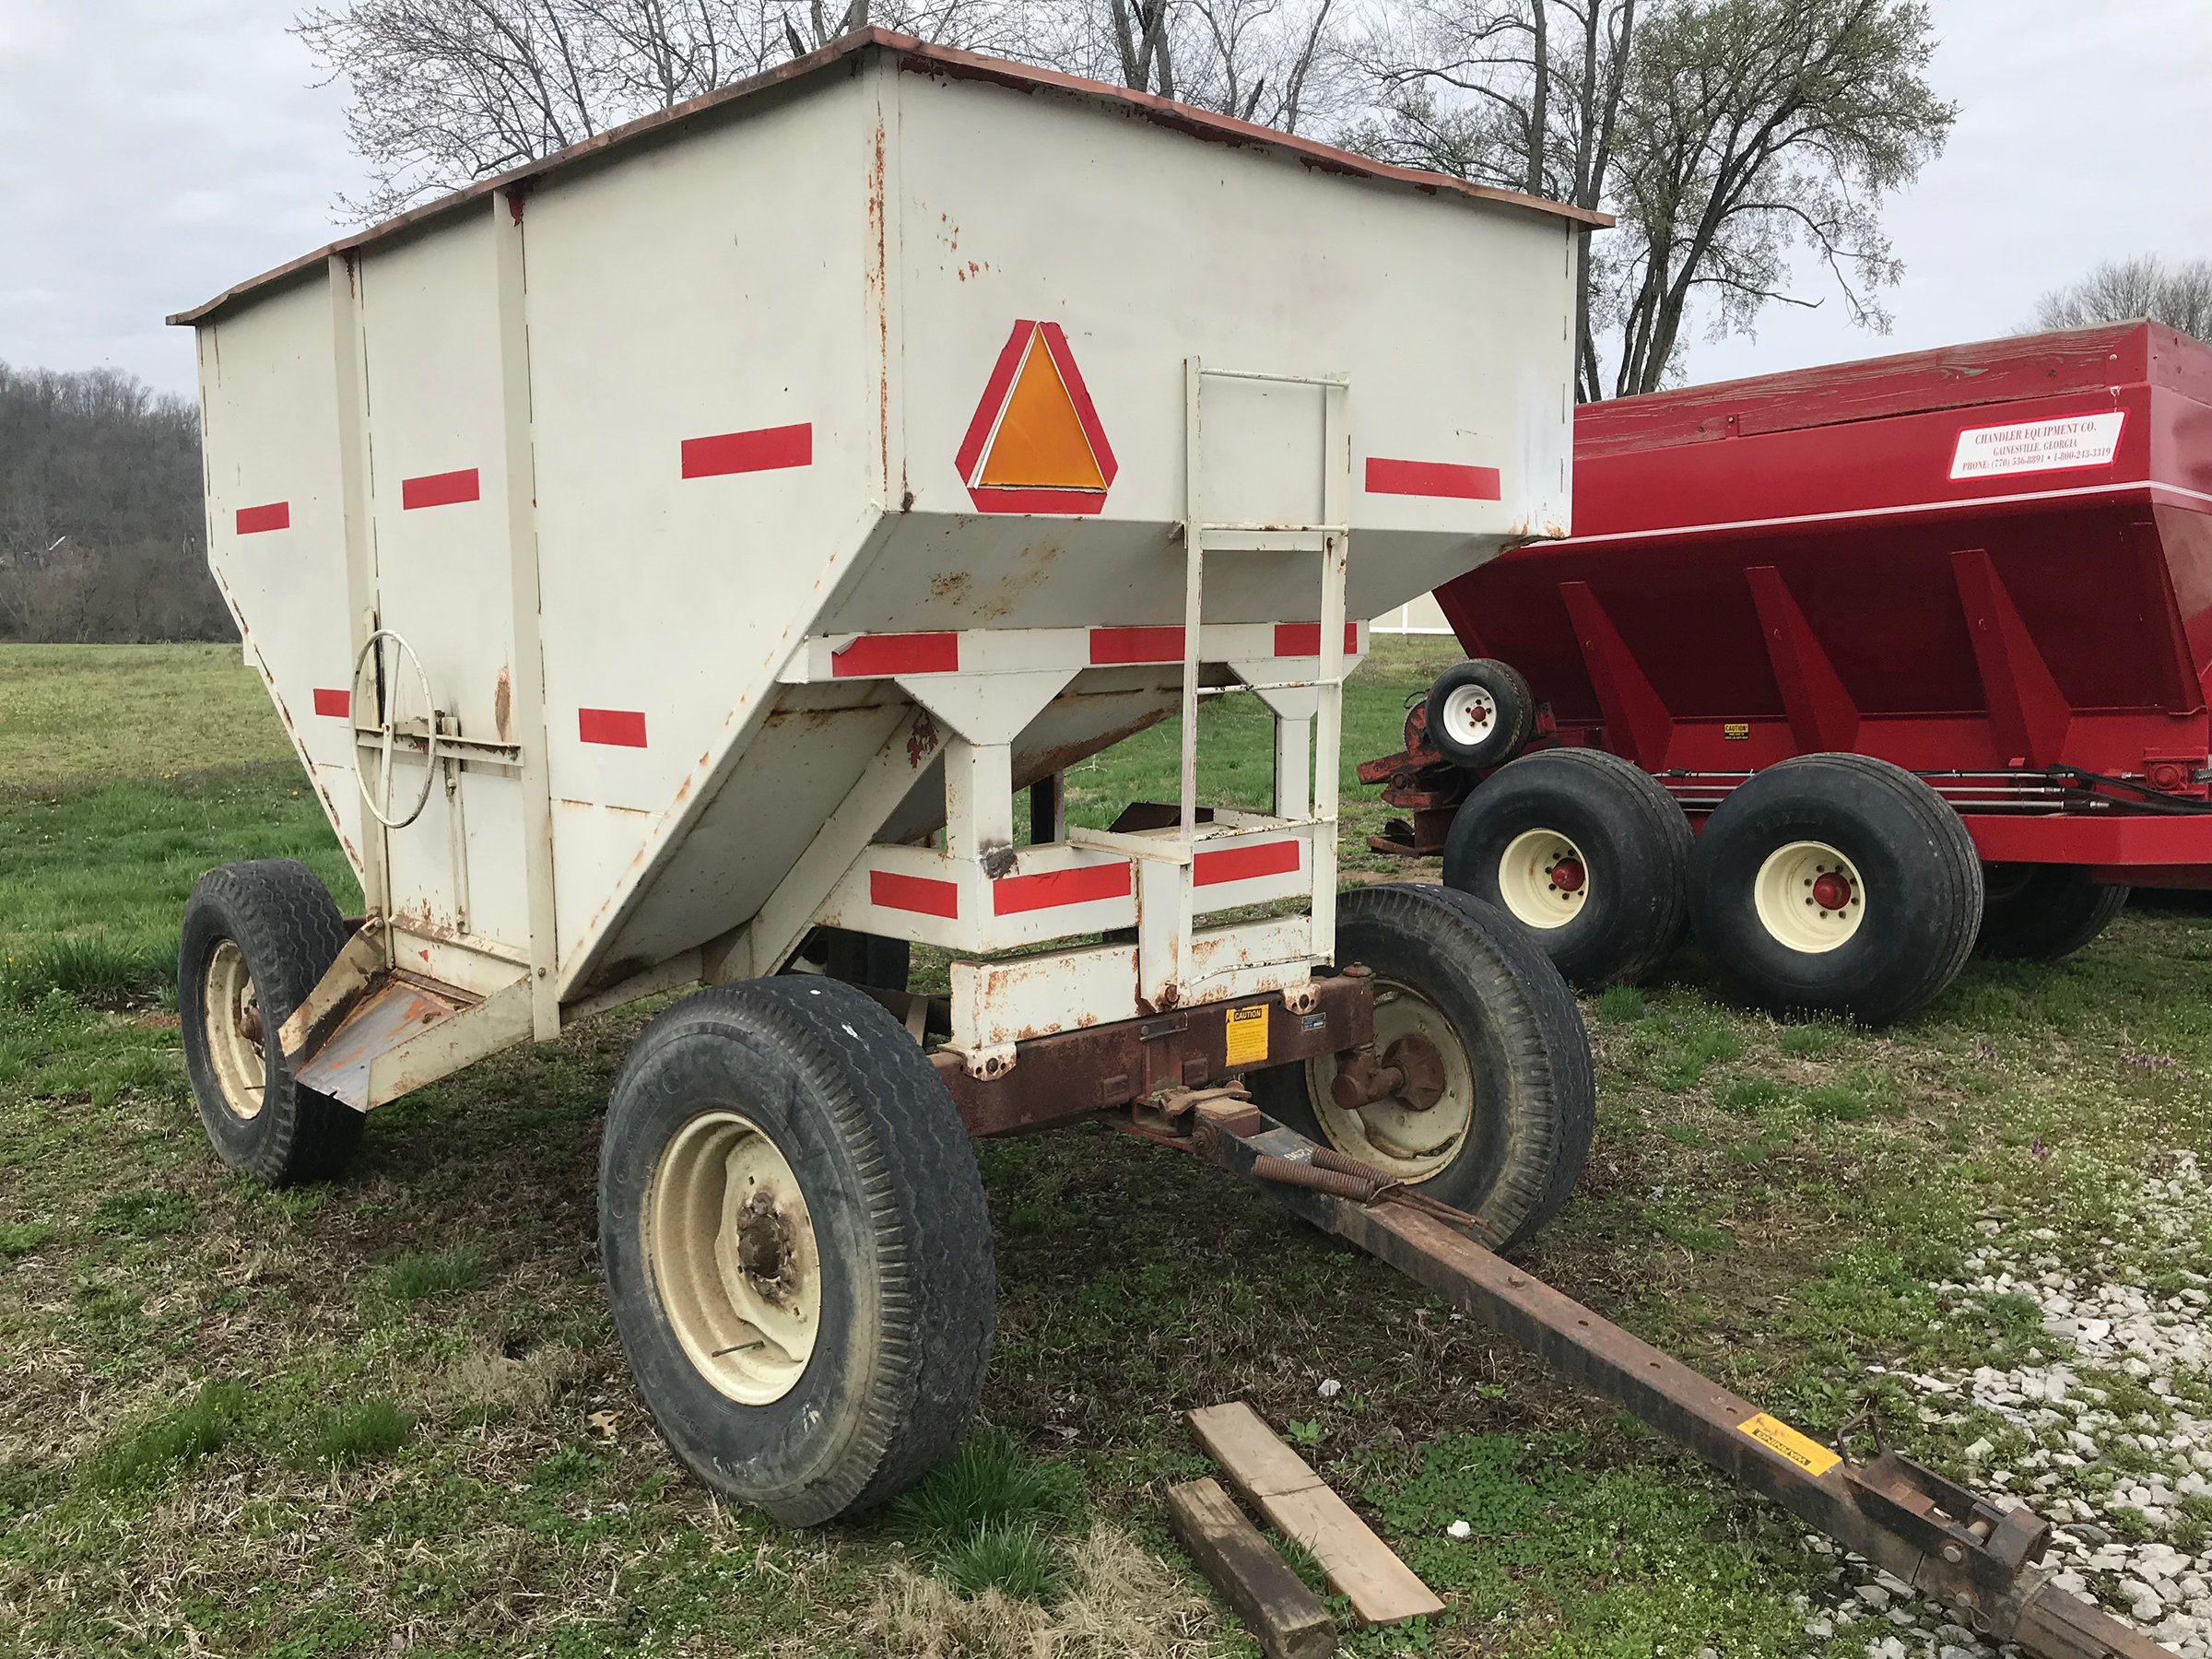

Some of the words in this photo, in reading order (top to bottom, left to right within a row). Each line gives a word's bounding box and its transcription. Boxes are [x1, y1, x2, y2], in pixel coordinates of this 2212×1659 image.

[1975, 429, 2022, 444] CHANDLER
[2025, 423, 2078, 440] EQUIPMENT
[2080, 421, 2097, 432] CO.
[1993, 442, 2041, 456] GAINESVILLE,
[2043, 439, 2077, 451] GEORGIA
[1962, 461, 1990, 471] PHONE:
[1991, 458, 2010, 469] (770)
[2012, 455, 2044, 466] 536-8891
[1235, 1009, 1261, 1020] CAUTION
[1756, 1430, 1807, 1465] WARNING
